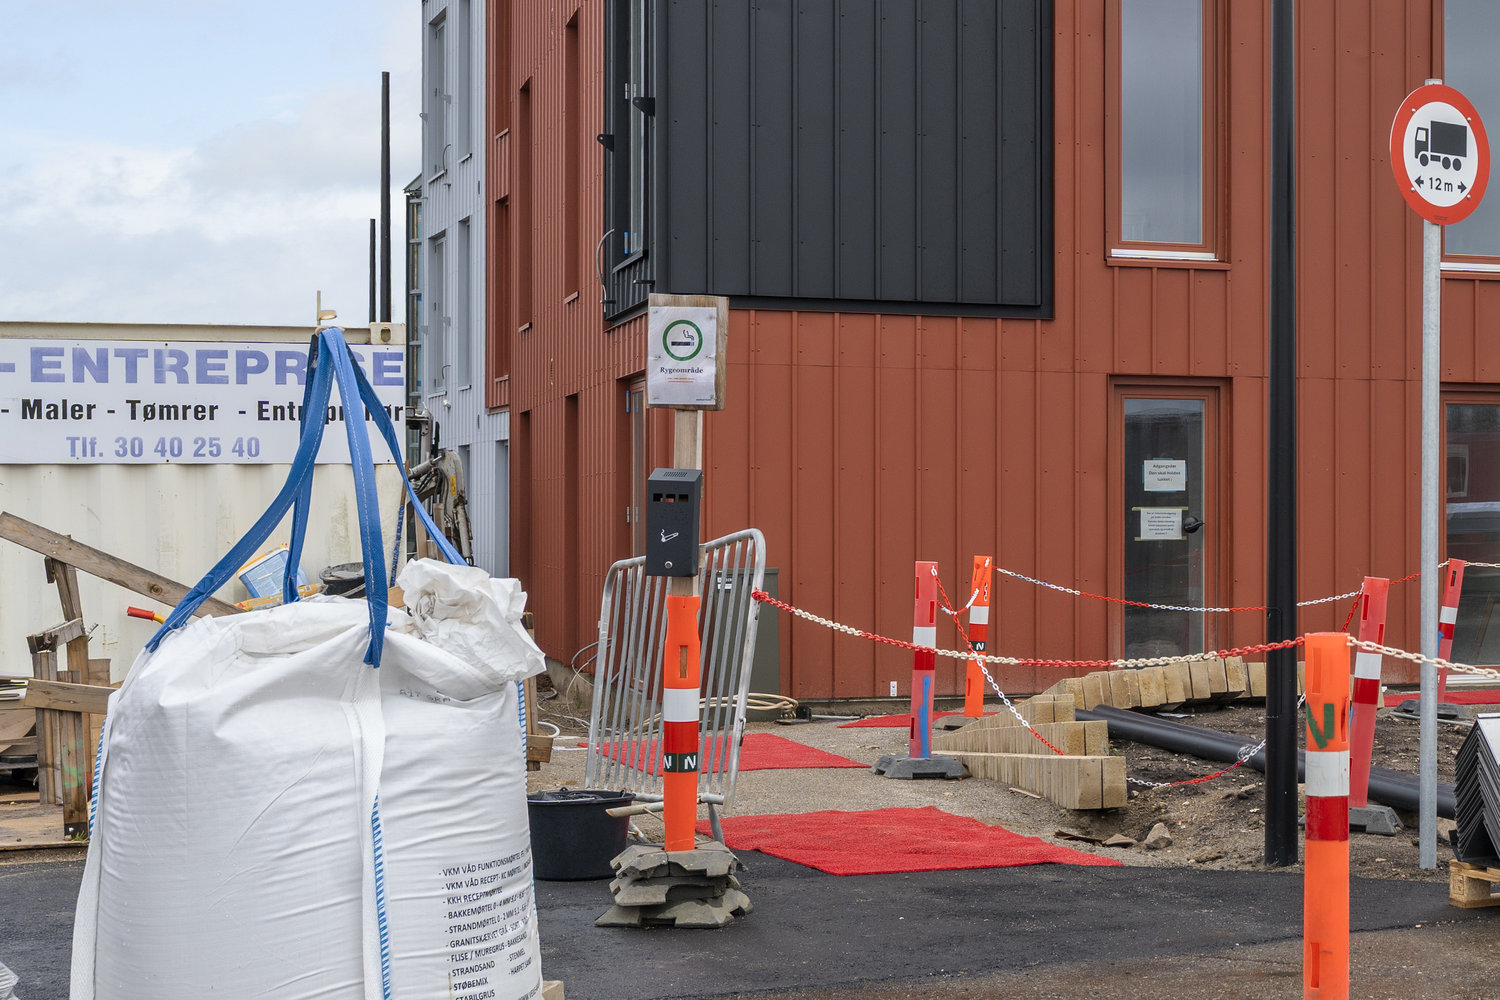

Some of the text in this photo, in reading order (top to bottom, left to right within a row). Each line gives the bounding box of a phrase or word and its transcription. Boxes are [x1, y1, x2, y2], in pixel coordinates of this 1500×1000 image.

[30, 347, 404, 386] ENTREPRE
[21, 399, 96, 420] Maler
[126, 400, 218, 422] Tømrer
[66, 437, 260, 457] Tlf. 30 40 25 40
[442, 867, 460, 877] VKM
[461, 864, 477, 874] VÅD
[446, 881, 463, 890] VKM
[464, 877, 479, 887] VÅD
[447, 896, 461, 905] KKH
[448, 903, 493, 919] BAKKEMØRTEL
[449, 917, 497, 934] STRANDMØRTEL
[451, 953, 468, 962] FLISE
[475, 942, 505, 958] MUREGRUS
[452, 960, 495, 977] STRANDSAND
[453, 977, 488, 991] STØBEMIX
